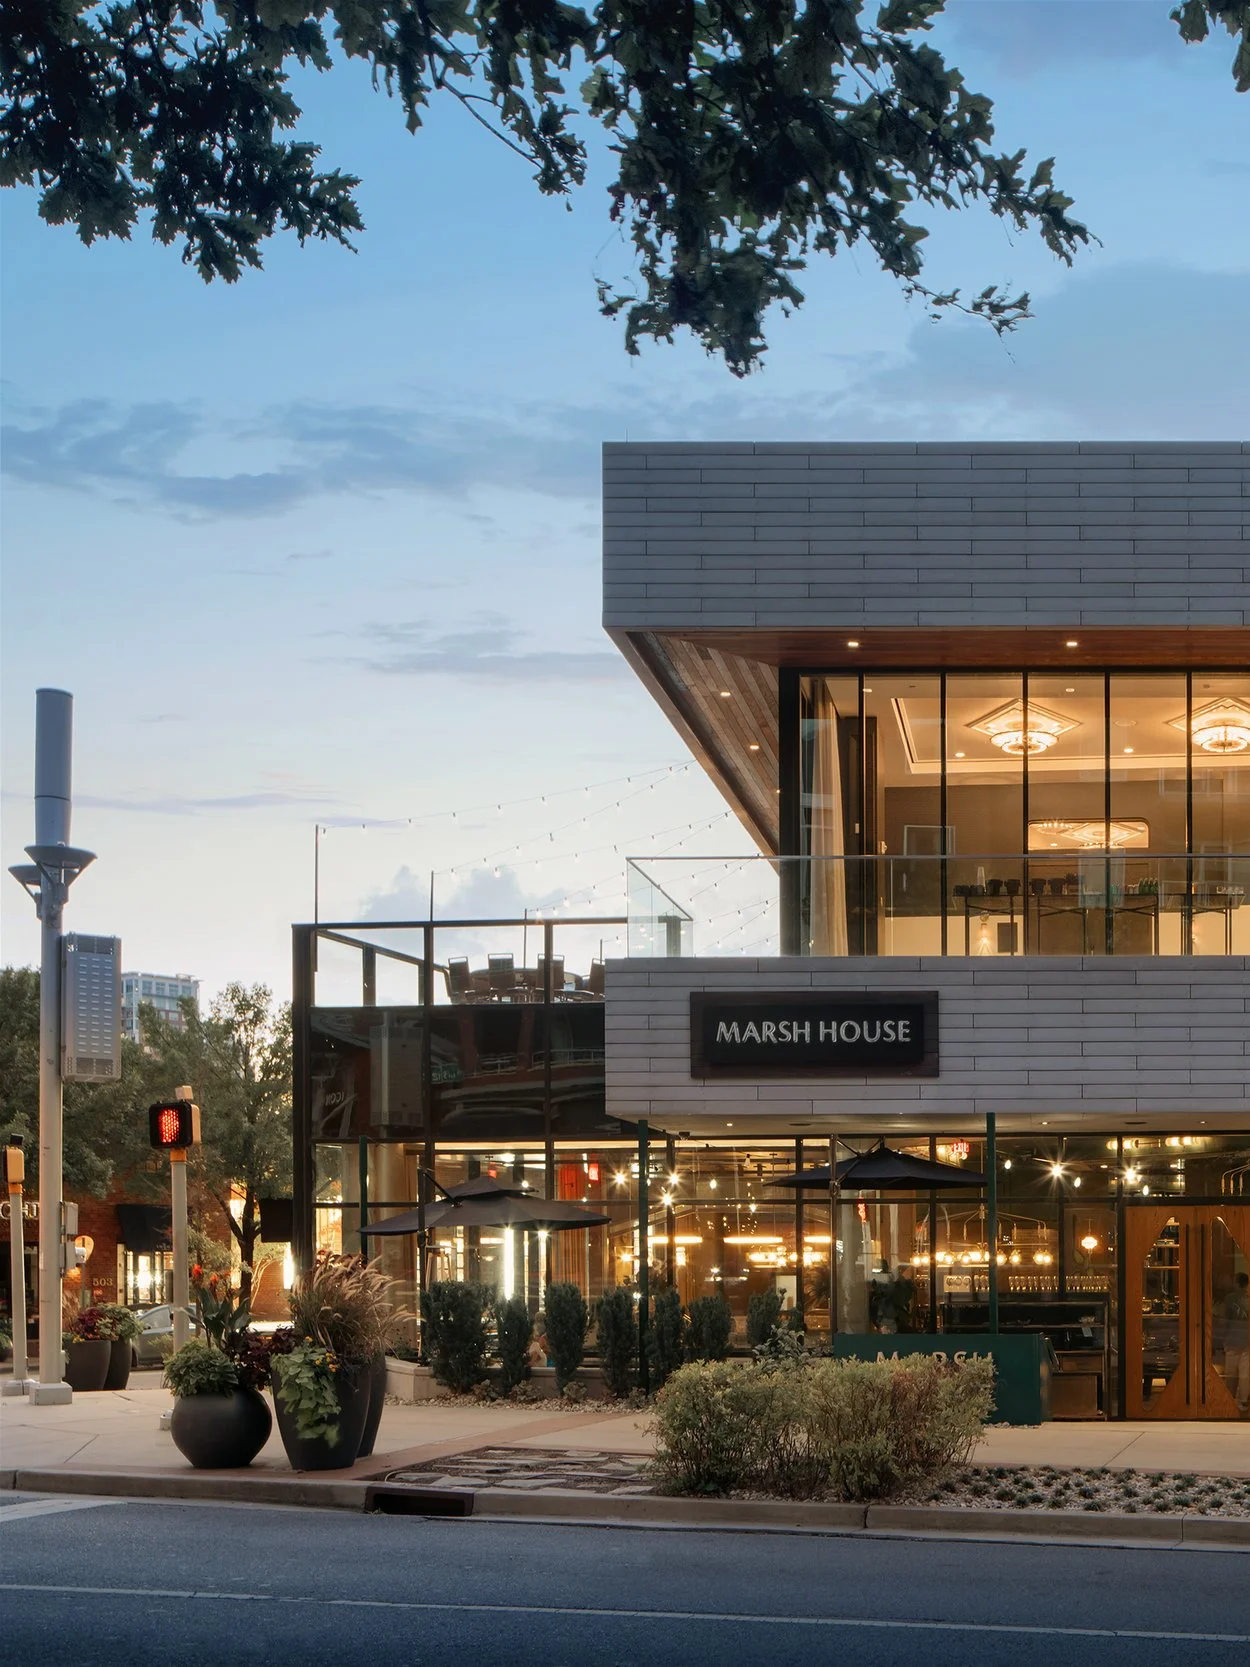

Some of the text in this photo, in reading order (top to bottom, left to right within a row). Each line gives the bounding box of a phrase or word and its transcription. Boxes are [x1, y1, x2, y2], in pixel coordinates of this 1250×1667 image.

[716, 1021, 911, 1043] MARSH HOUSE
[93, 1277, 113, 1287] 503
